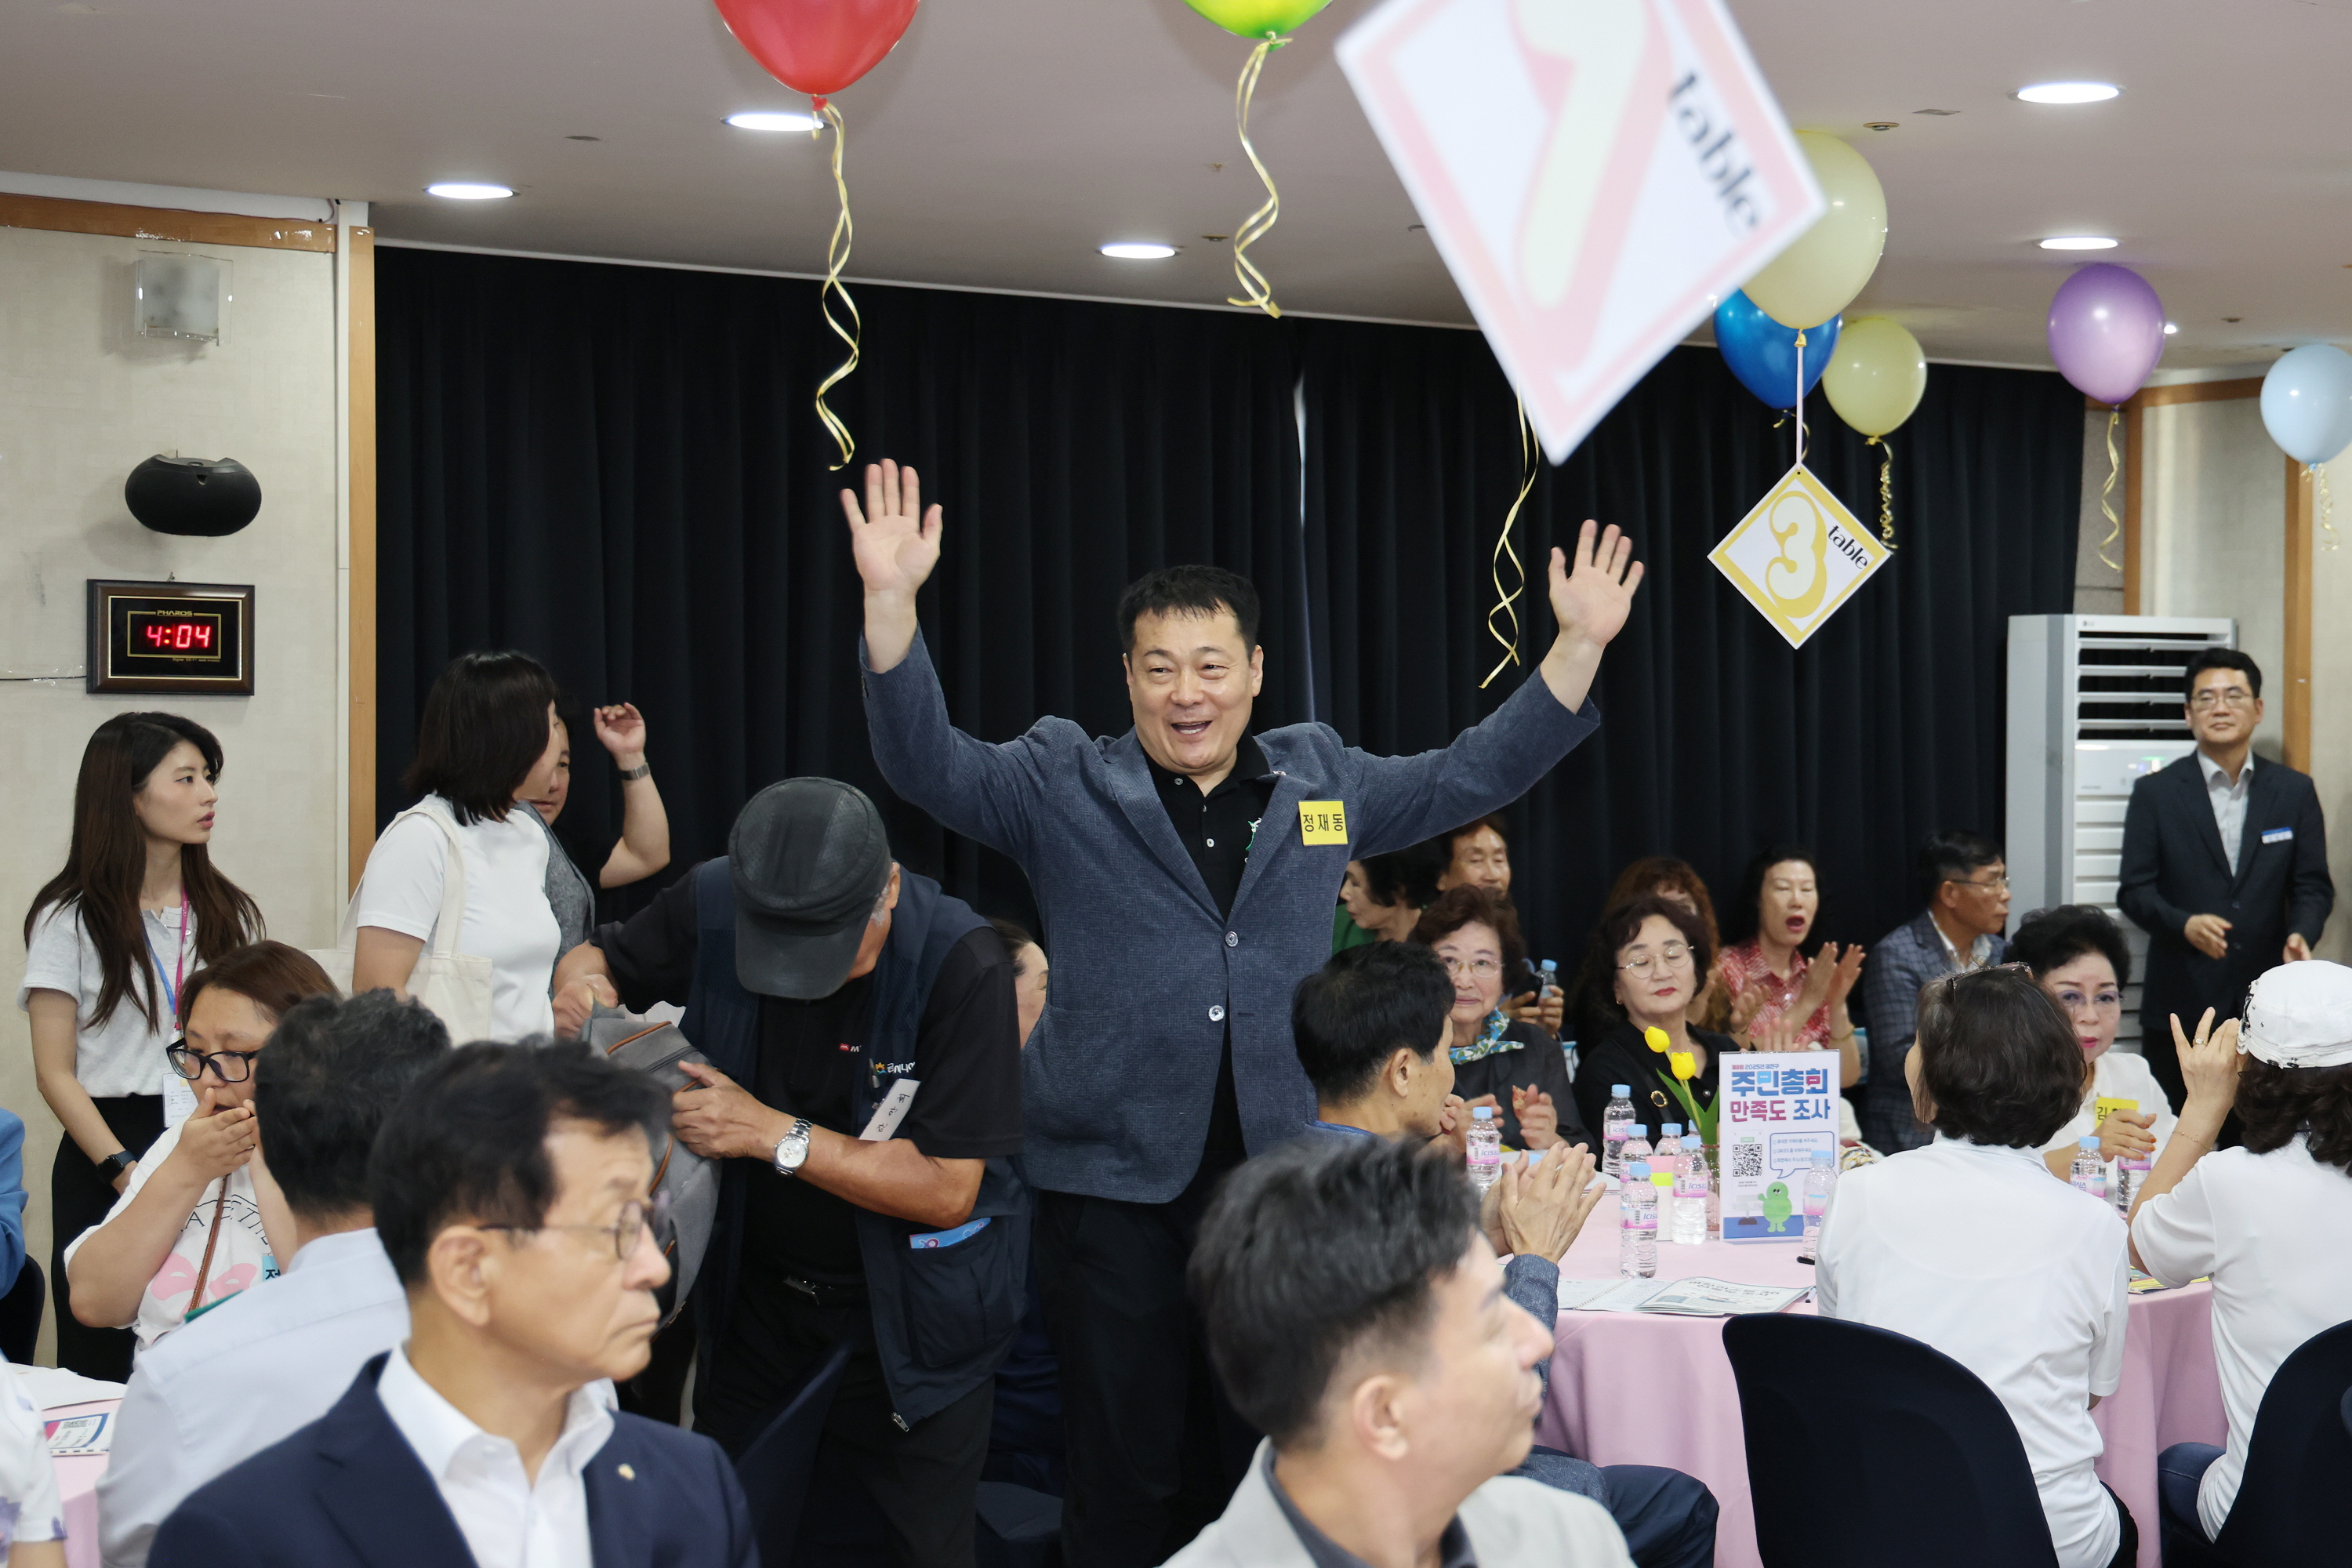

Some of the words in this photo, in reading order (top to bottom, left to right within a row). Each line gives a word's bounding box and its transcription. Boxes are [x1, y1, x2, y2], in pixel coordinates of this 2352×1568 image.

[1668, 69, 1762, 237] table
[1766, 492, 1824, 613] 3
[1828, 525, 1868, 570] table
[147, 625, 210, 648] 4:04
[1303, 814, 1343, 833] 정재동
[1732, 1068, 1828, 1097] 주민총회
[1730, 1100, 1787, 1122] 만족도
[1793, 1099, 1831, 1120] 조사
